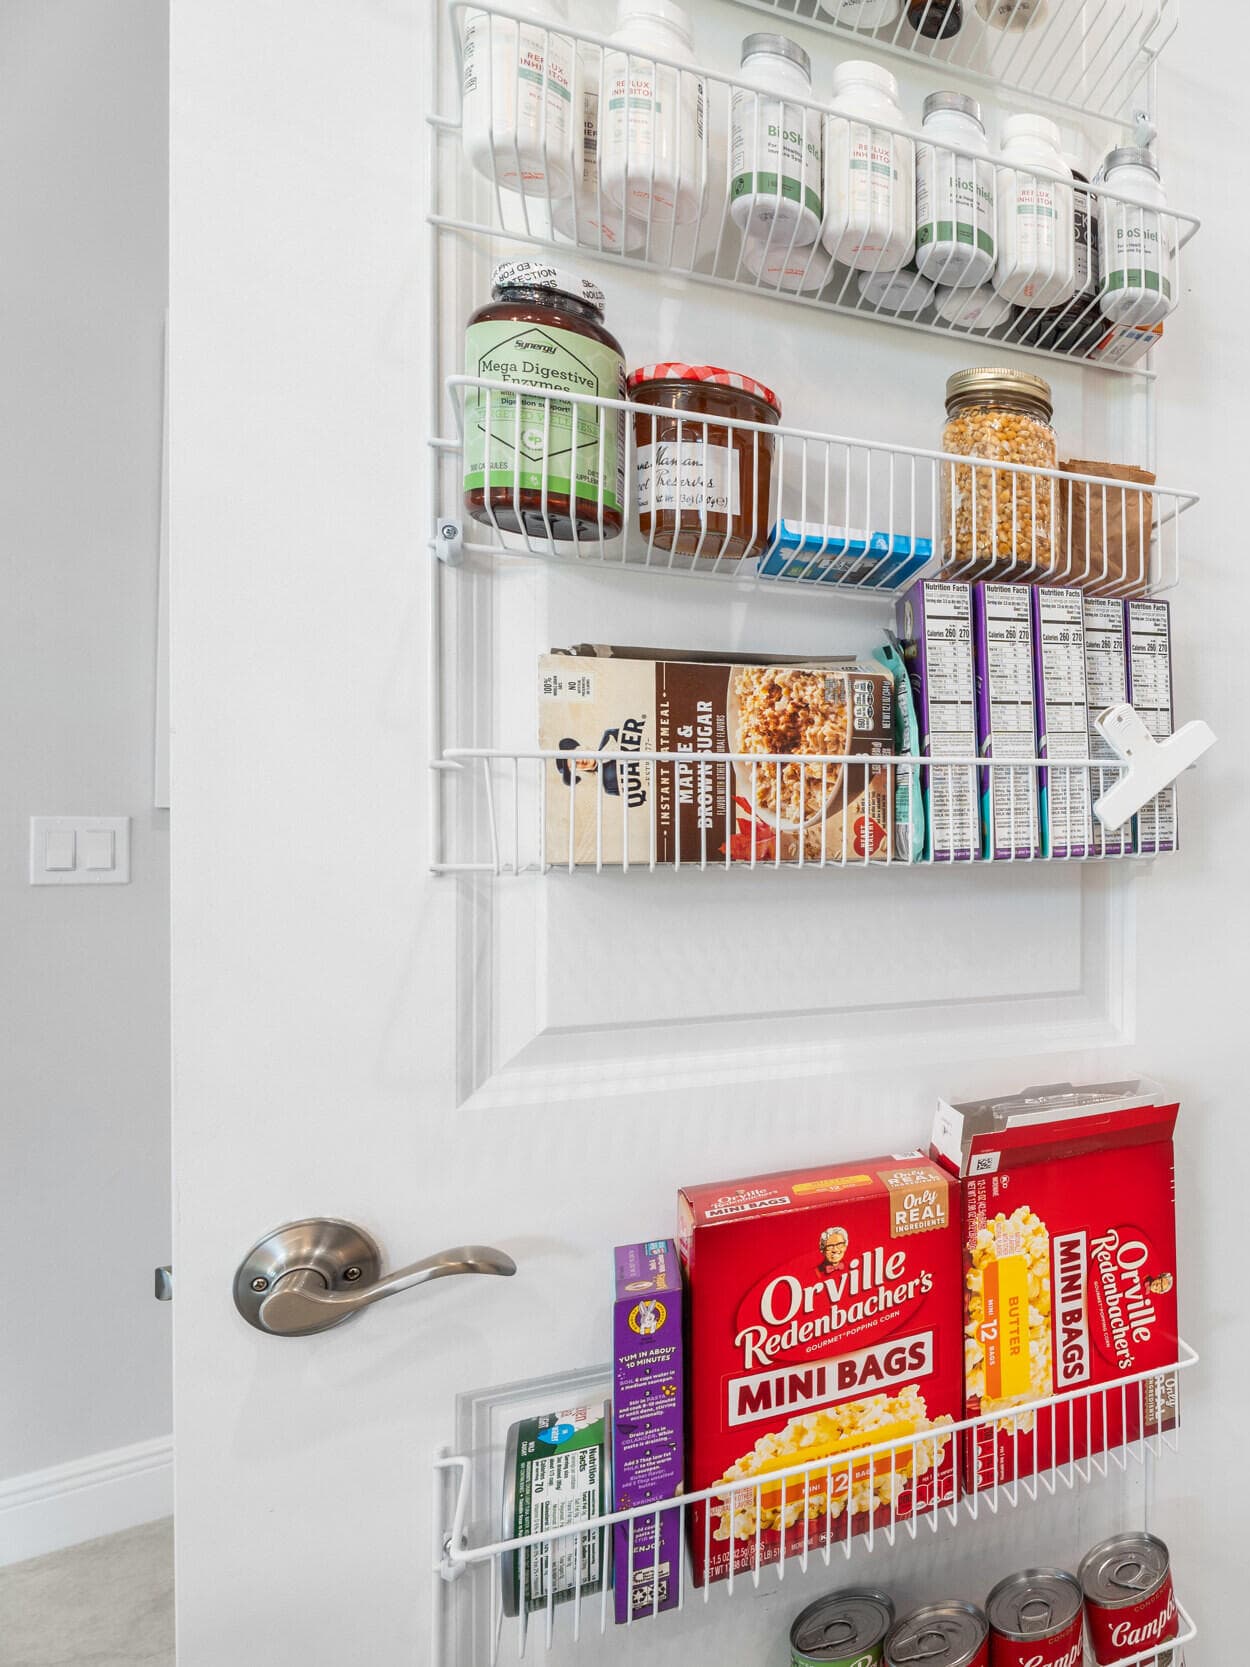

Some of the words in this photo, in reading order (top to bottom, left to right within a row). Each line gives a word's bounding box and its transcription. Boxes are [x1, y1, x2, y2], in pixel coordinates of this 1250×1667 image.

[520, 59, 568, 86] INHIITOR
[527, 52, 564, 74] REFUX
[512, 269, 557, 284] TECTION
[514, 340, 559, 355] Synergy
[482, 360, 517, 374] Mega
[522, 361, 595, 389] Digestive
[502, 375, 571, 392] Enzymes
[924, 583, 951, 592] Nutrition
[952, 584, 968, 592] Facts
[986, 585, 1011, 593] Nutrition
[1012, 586, 1028, 594] Facts
[1040, 589, 1064, 597] Nutrition
[1065, 590, 1080, 598] Facts
[927, 630, 944, 638] Calories
[945, 628, 956, 638] 260
[959, 628, 969, 638] 270
[1005, 630, 1016, 639] 260
[1019, 630, 1029, 640] 270
[1059, 632, 1070, 642] 260
[1072, 633, 1082, 642] 270
[1113, 640, 1122, 649] 270
[660, 701, 670, 762] ATMEAL
[677, 725, 693, 738] &
[697, 701, 713, 756] SUGAR
[620, 718, 647, 808] QUAKER
[661, 769, 670, 825] INSTANT
[709, 1205, 745, 1217] MINI
[750, 1198, 787, 1209] BAGS
[903, 1189, 937, 1210] Only
[895, 1205, 945, 1225] REAL
[895, 1218, 945, 1233] INGREDIENTS
[1059, 1239, 1083, 1304] MINI
[761, 1246, 906, 1326] Orville
[1115, 1240, 1157, 1344] Orville
[1090, 1228, 1136, 1370] Redenbacher's
[734, 1269, 933, 1370] Redenbacher's
[980, 1318, 998, 1342] 12
[1008, 1295, 1021, 1356] BUTTER
[806, 1334, 842, 1353] GOURMET
[846, 1320, 878, 1338] POPPING
[880, 1311, 900, 1323] CORN
[619, 1354, 637, 1363] YUM
[649, 1346, 676, 1357] ABOUT
[1061, 1307, 1085, 1380] BAGS
[626, 1361, 635, 1369] 10
[636, 1355, 671, 1366] MINUTES
[737, 1366, 826, 1417] MINI
[837, 1341, 926, 1392] BAGS
[579, 1449, 588, 1472] Facts
[589, 1447, 598, 1485] Nutrition
[534, 1482, 543, 1494] 70
[828, 1473, 850, 1495] 12
[1108, 1588, 1177, 1648] Campb
